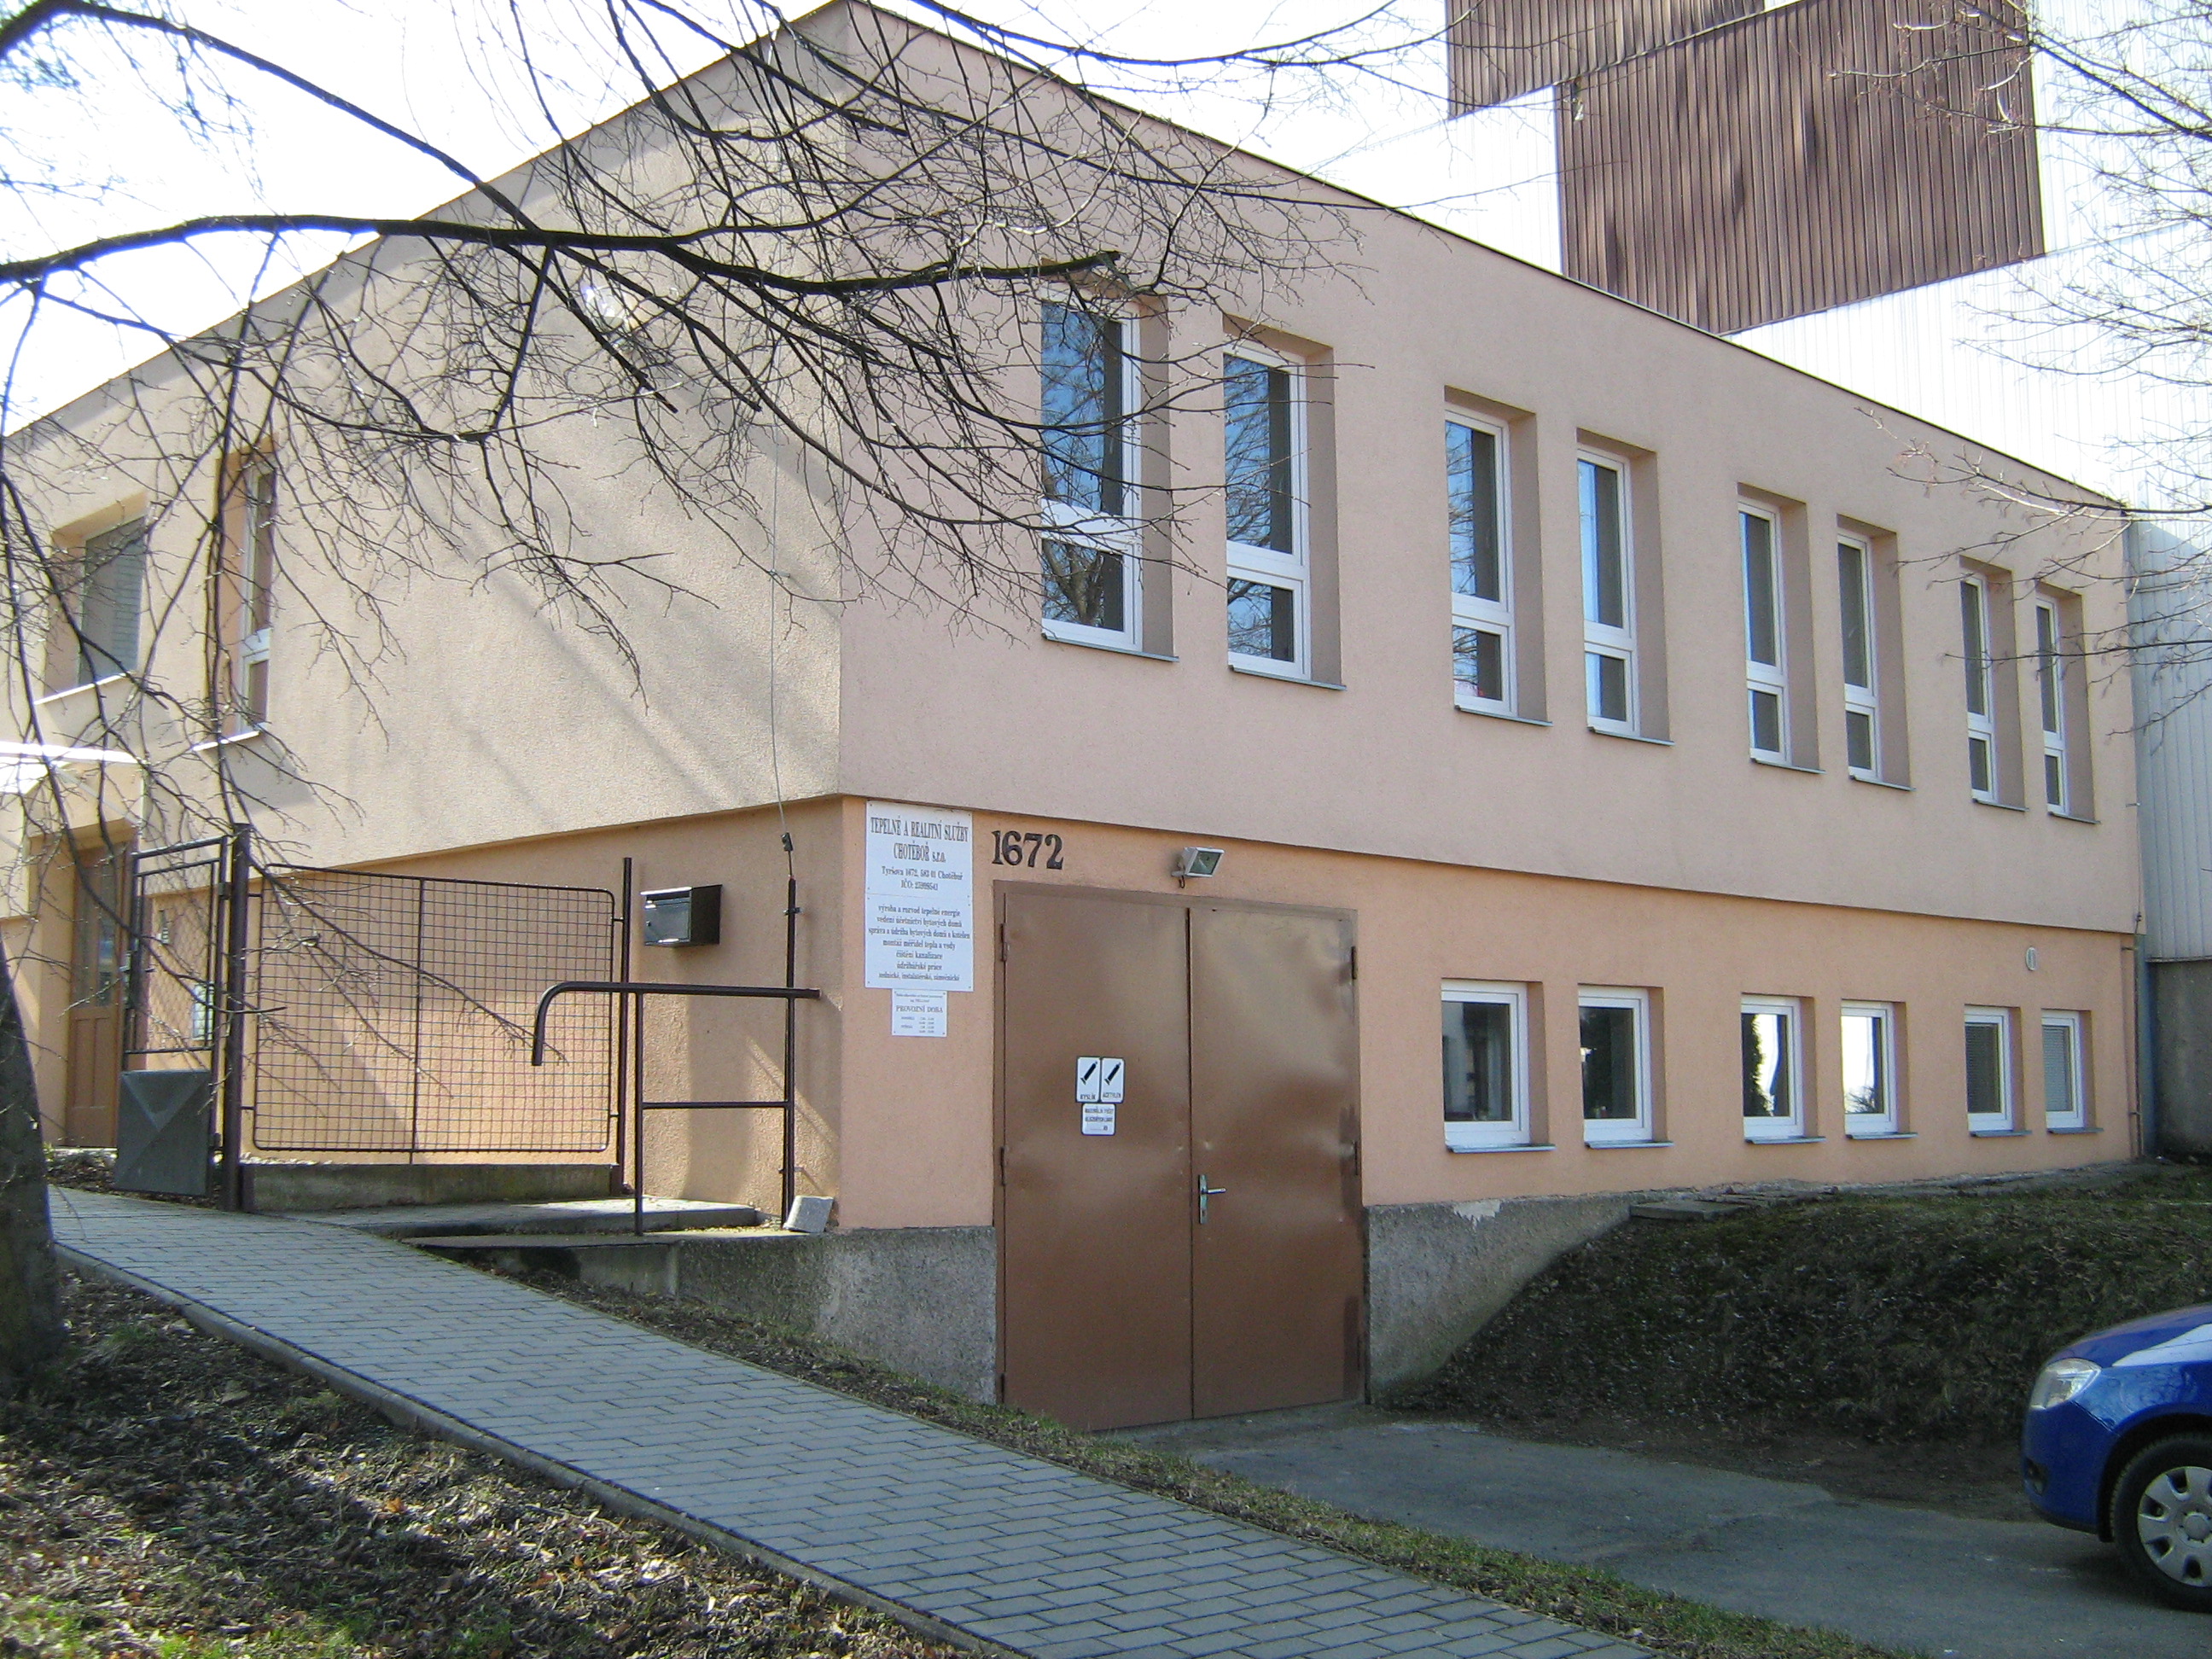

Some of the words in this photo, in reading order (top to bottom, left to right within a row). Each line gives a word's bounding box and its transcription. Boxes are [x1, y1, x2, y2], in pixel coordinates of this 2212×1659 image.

[870, 816, 900, 835] TEPELNÉ
[904, 823, 909, 835] A
[911, 820, 942, 840] REALITNÍ
[945, 822, 969, 841] SLUŽBY
[894, 841, 929, 861] CHOTĚBOŘ
[933, 852, 946, 862] s.r.o.
[992, 830, 1063, 870] 1672
